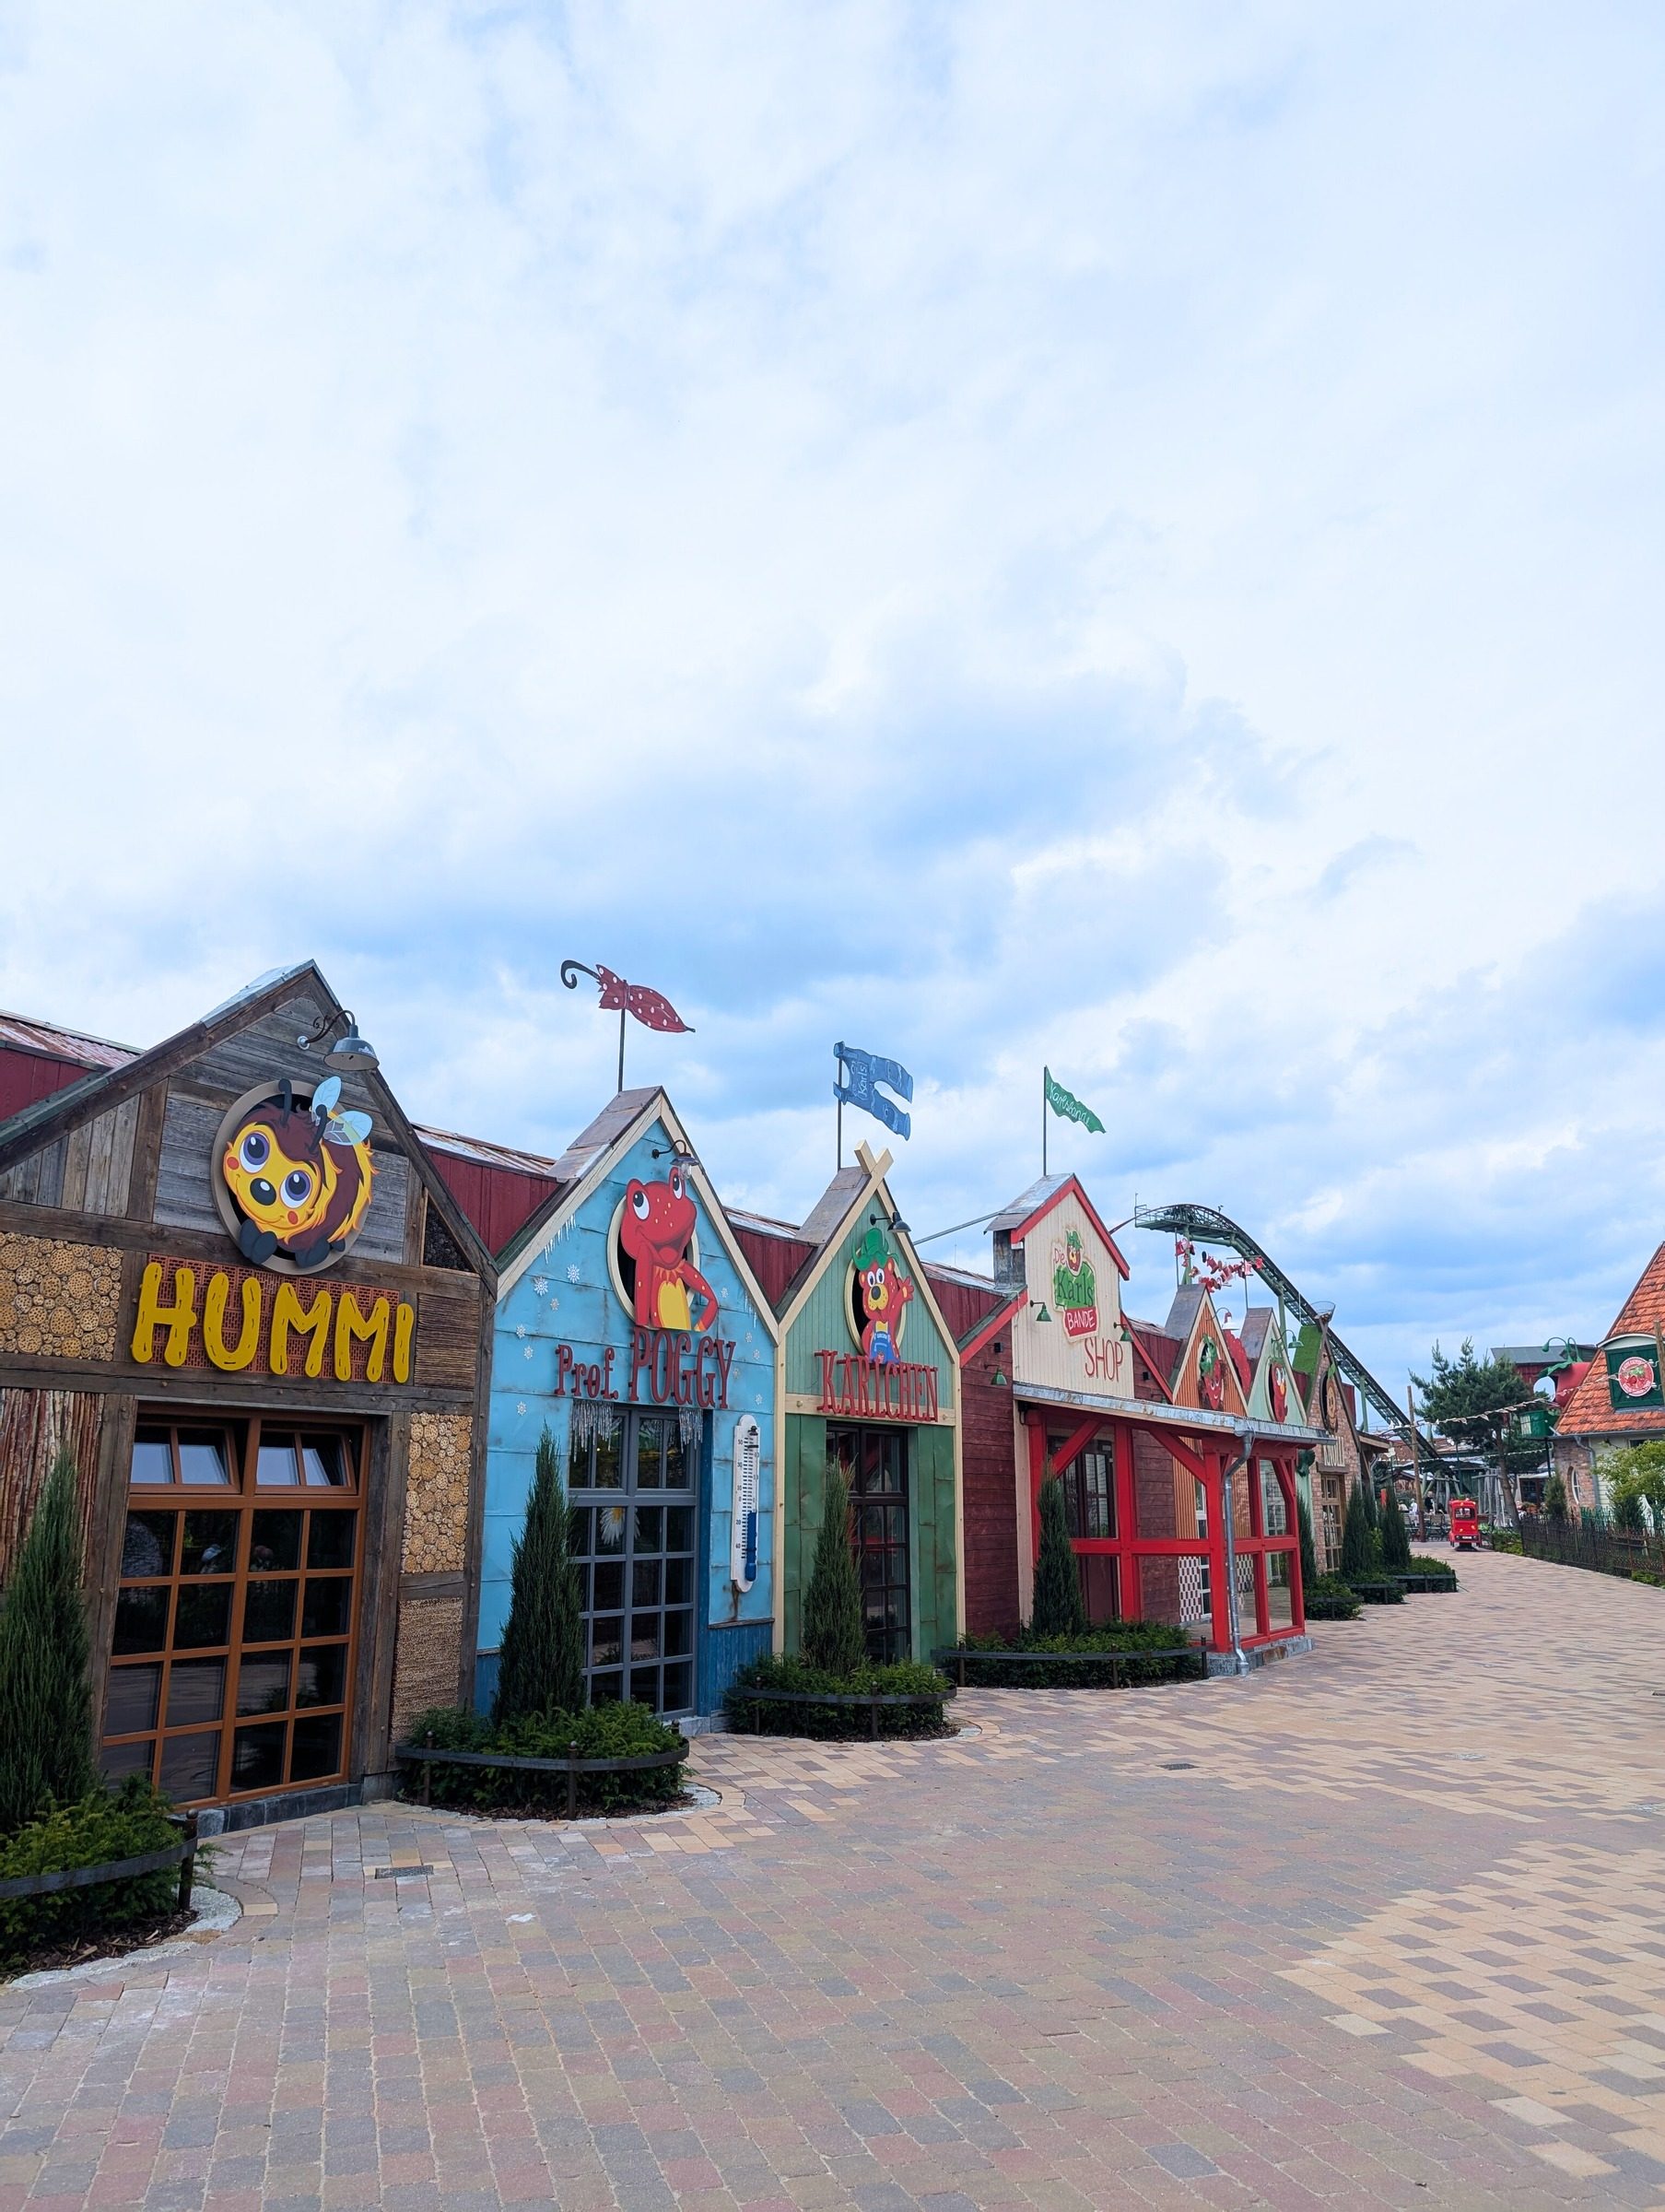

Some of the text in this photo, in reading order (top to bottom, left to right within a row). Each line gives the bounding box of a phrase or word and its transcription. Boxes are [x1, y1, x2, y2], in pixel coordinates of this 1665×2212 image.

[858, 1064, 869, 1099] Karls
[1054, 1248, 1066, 1265] Die
[1057, 1269, 1095, 1308] Karls
[132, 1262, 414, 1382] HUMMI
[1067, 1310, 1096, 1329] BANDE
[555, 1327, 736, 1408] Prof. POGGY
[1085, 1336, 1123, 1382] SHOP
[816, 1349, 938, 1422] KARLCHEN
